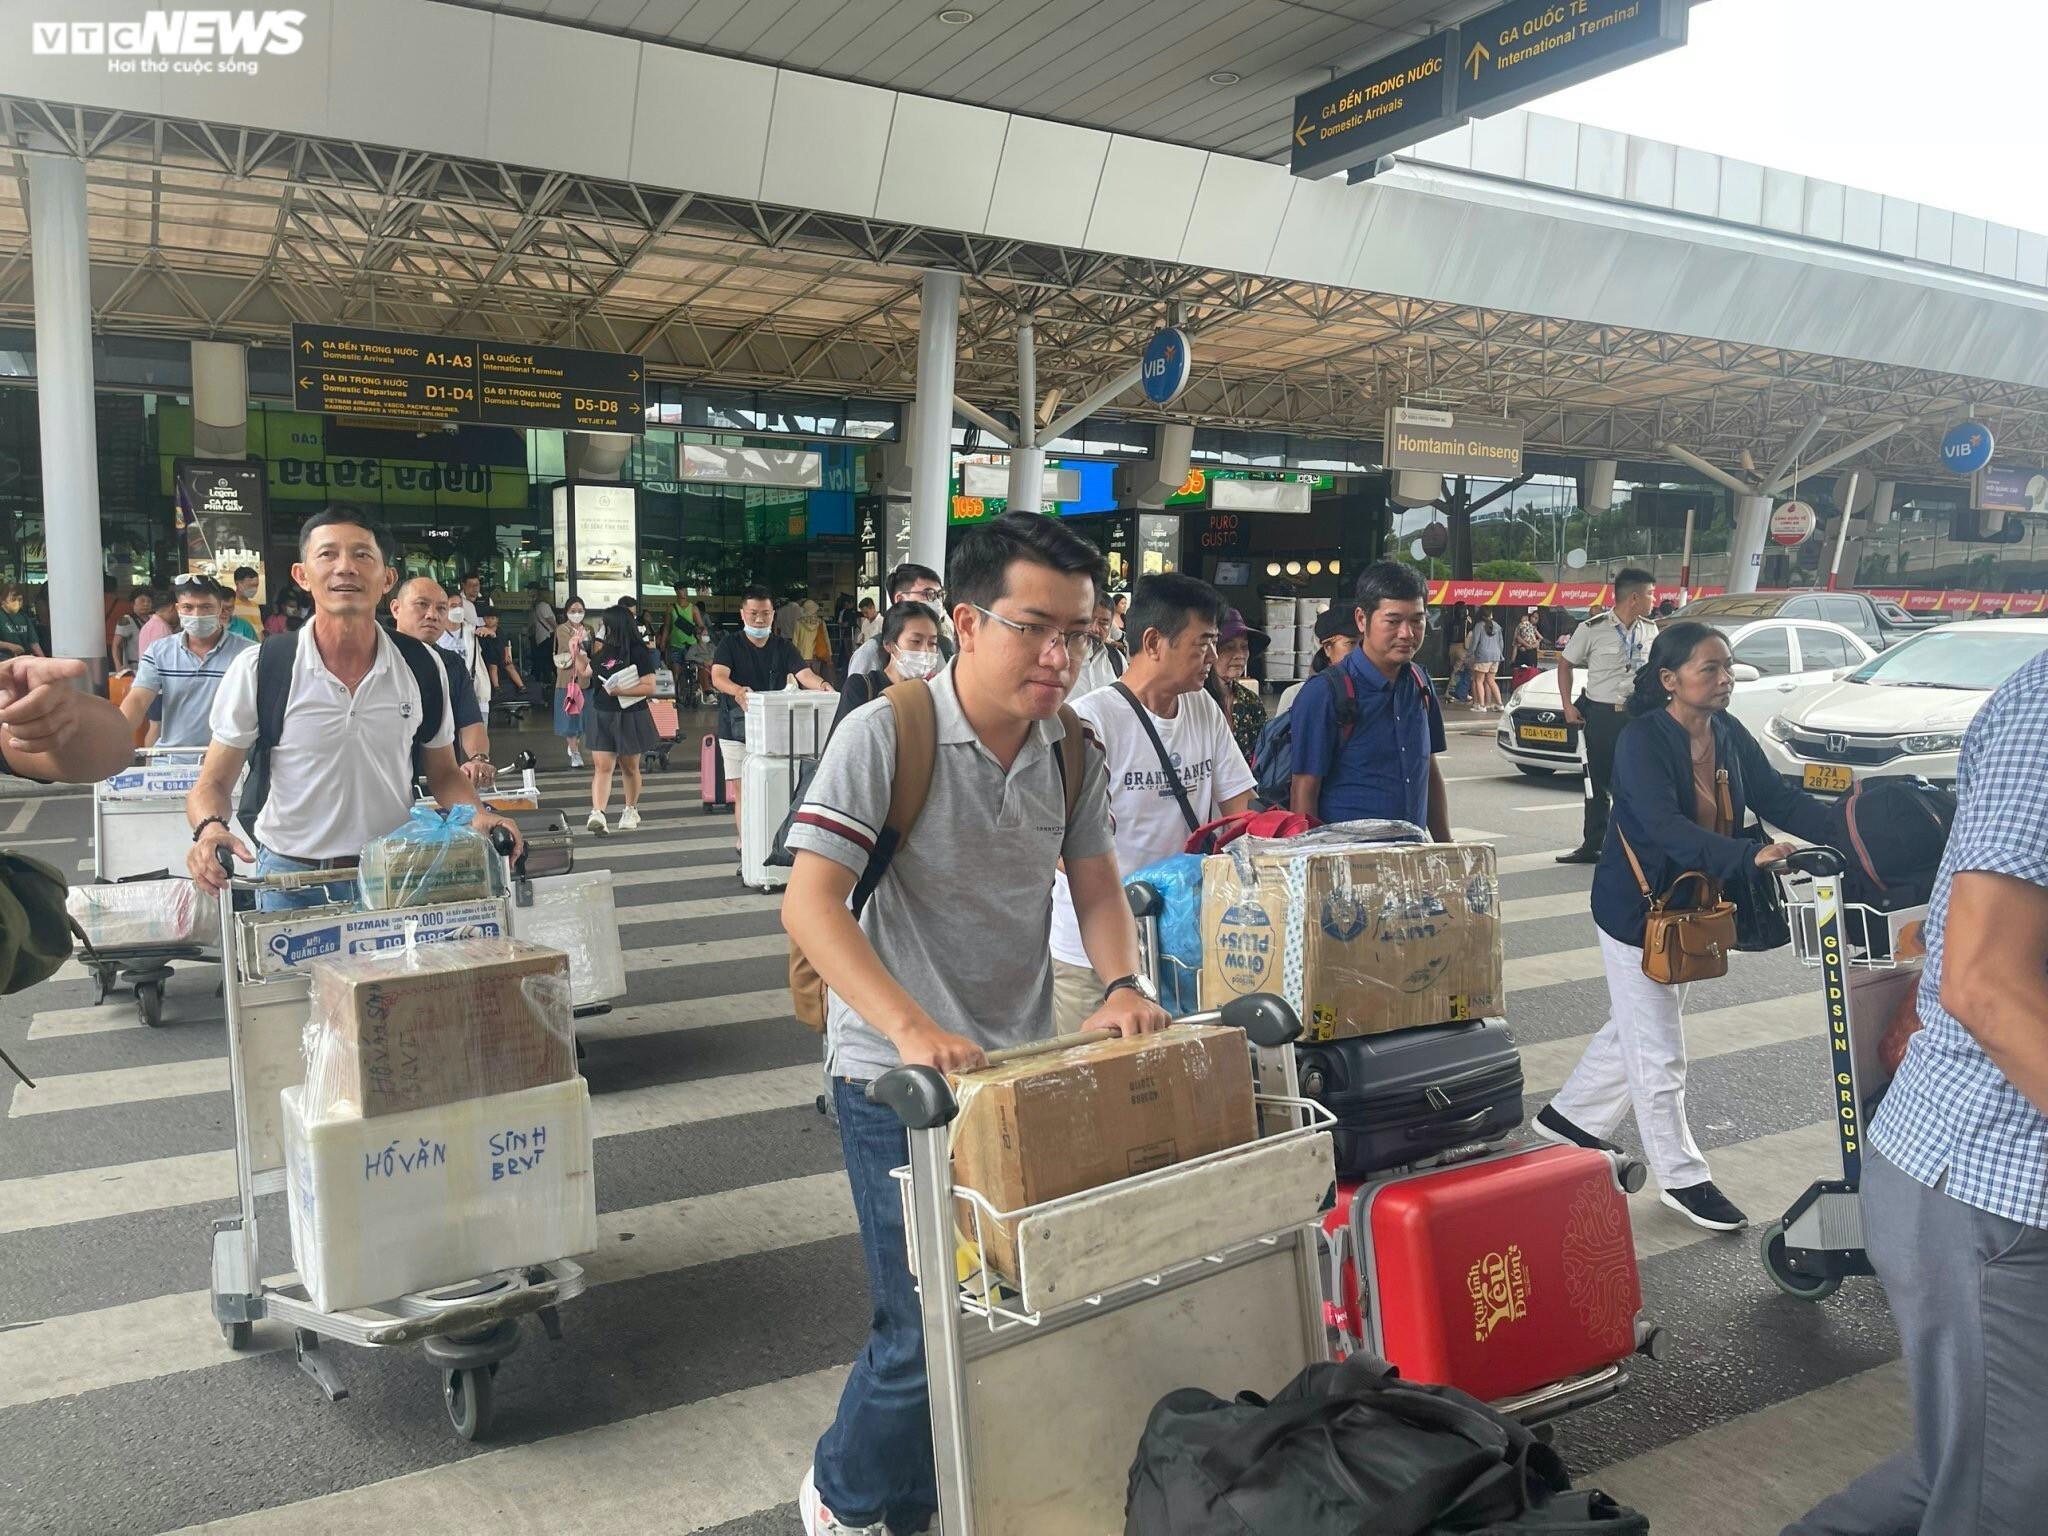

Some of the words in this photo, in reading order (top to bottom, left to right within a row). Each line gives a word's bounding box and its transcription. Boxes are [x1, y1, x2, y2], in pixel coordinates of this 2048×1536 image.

[1499, 27, 1519, 46] GA
[1523, 5, 1565, 36] QUỐC
[1497, 27, 1576, 70] International
[1579, 2, 1640, 36] Terminal
[1321, 104, 1337, 119] GA
[1339, 90, 1362, 112] ĐẾN
[1365, 75, 1404, 101] TRONG
[1407, 57, 1443, 83] NƯỚC
[1320, 114, 1363, 140] Domestic
[1364, 98, 1404, 122] Arrivals
[322, 341, 336, 349] GA
[338, 340, 358, 351] ĐẾN
[360, 344, 391, 354] TRONG
[323, 351, 361, 361] Domestic
[363, 354, 395, 364] Arrivals
[426, 352, 472, 369] A1-A3
[482, 353, 495, 362] GA
[497, 353, 520, 363] QUỐC
[483, 364, 530, 374] International
[531, 366, 564, 376] Terminal
[1144, 358, 1166, 379] VIB
[322, 374, 336, 382] GA
[338, 374, 347, 383] ĐI
[350, 376, 381, 386] TRONG
[323, 384, 361, 394] Domestic
[363, 387, 407, 398] Departures
[426, 385, 474, 401] D1-D4
[484, 387, 496, 395] GA
[509, 389, 537, 398] TRONG
[484, 397, 519, 406] Domestic
[521, 399, 561, 409] Departures
[574, 398, 619, 413] D5-D8
[577, 417, 604, 425] VIETJET
[606, 418, 617, 426] AIR
[1397, 433, 1465, 456] Homtamin
[1468, 441, 1519, 463] Ginseng
[1945, 443, 1971, 458] VIB
[952, 495, 984, 518] 1055
[1210, 514, 1239, 529] PURO
[1201, 531, 1238, 546] GUSTO
[346, 919, 389, 931] BIZMAN
[1219, 932, 1269, 954] PLUS+
[1225, 953, 1265, 975] Grow
[1823, 935, 1847, 1051] GOLDSUN
[1837, 1072, 1856, 1153] GROUP
